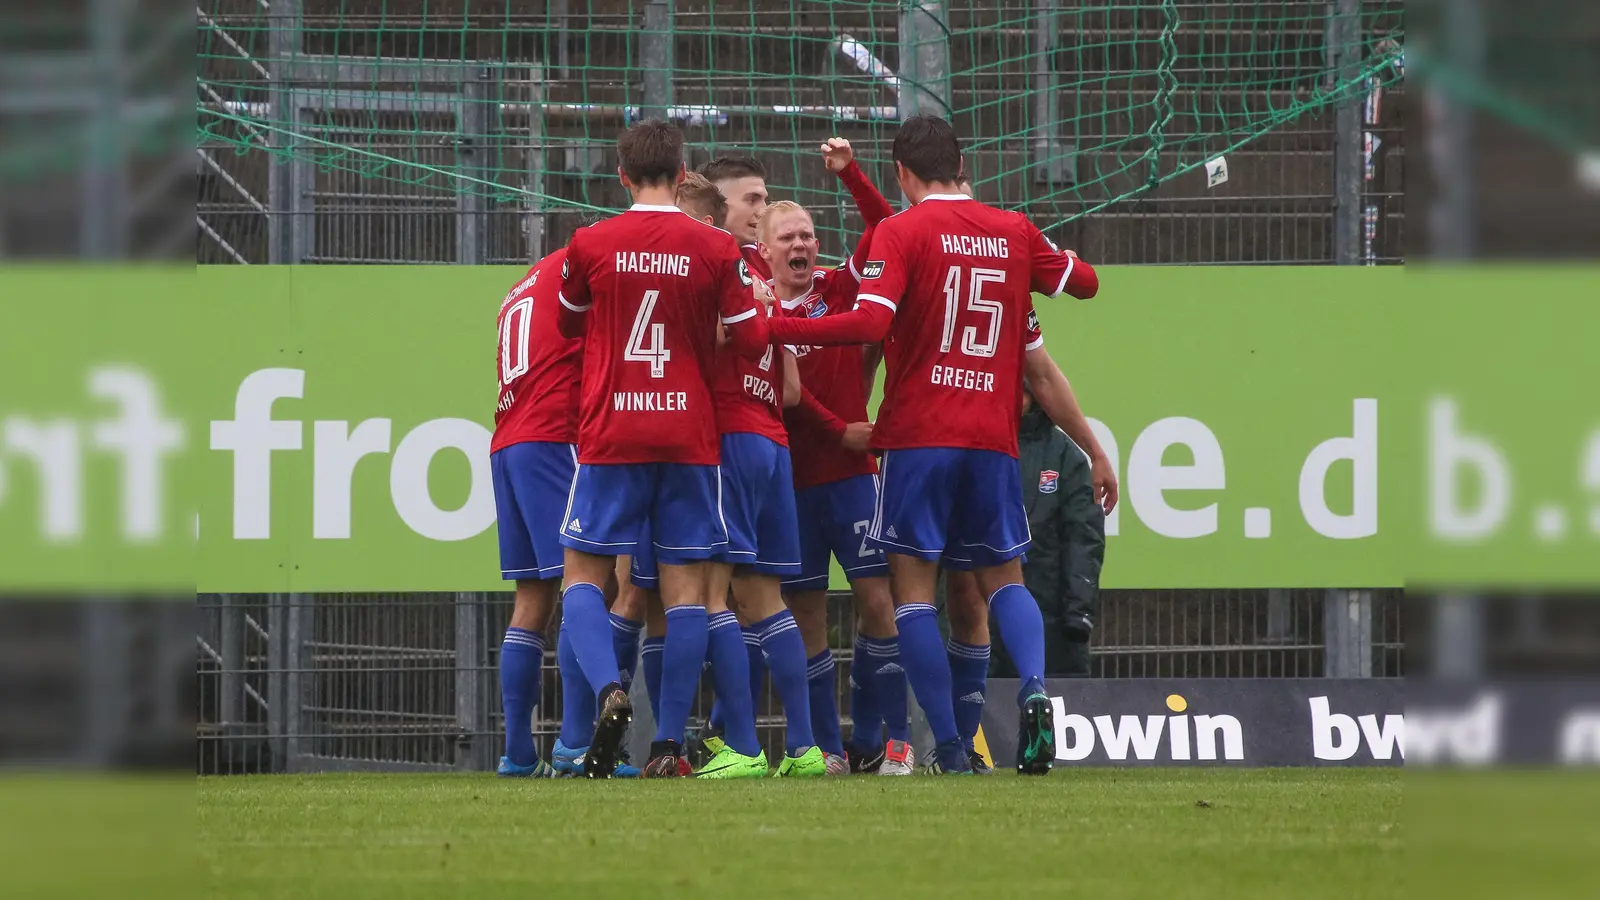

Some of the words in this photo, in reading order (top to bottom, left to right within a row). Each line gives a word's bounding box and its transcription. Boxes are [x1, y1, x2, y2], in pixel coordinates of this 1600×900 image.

[616, 251, 690, 276] HACHING
[941, 234, 1009, 258] HACHING
[940, 265, 1006, 358] 15
[498, 296, 534, 386] 0
[624, 290, 671, 378] 4
[743, 374, 778, 407] PORA
[931, 364, 994, 393] GREGER
[614, 391, 688, 412] WINKLER
[853, 519, 885, 558] 2
[1051, 694, 1244, 762] bwin
